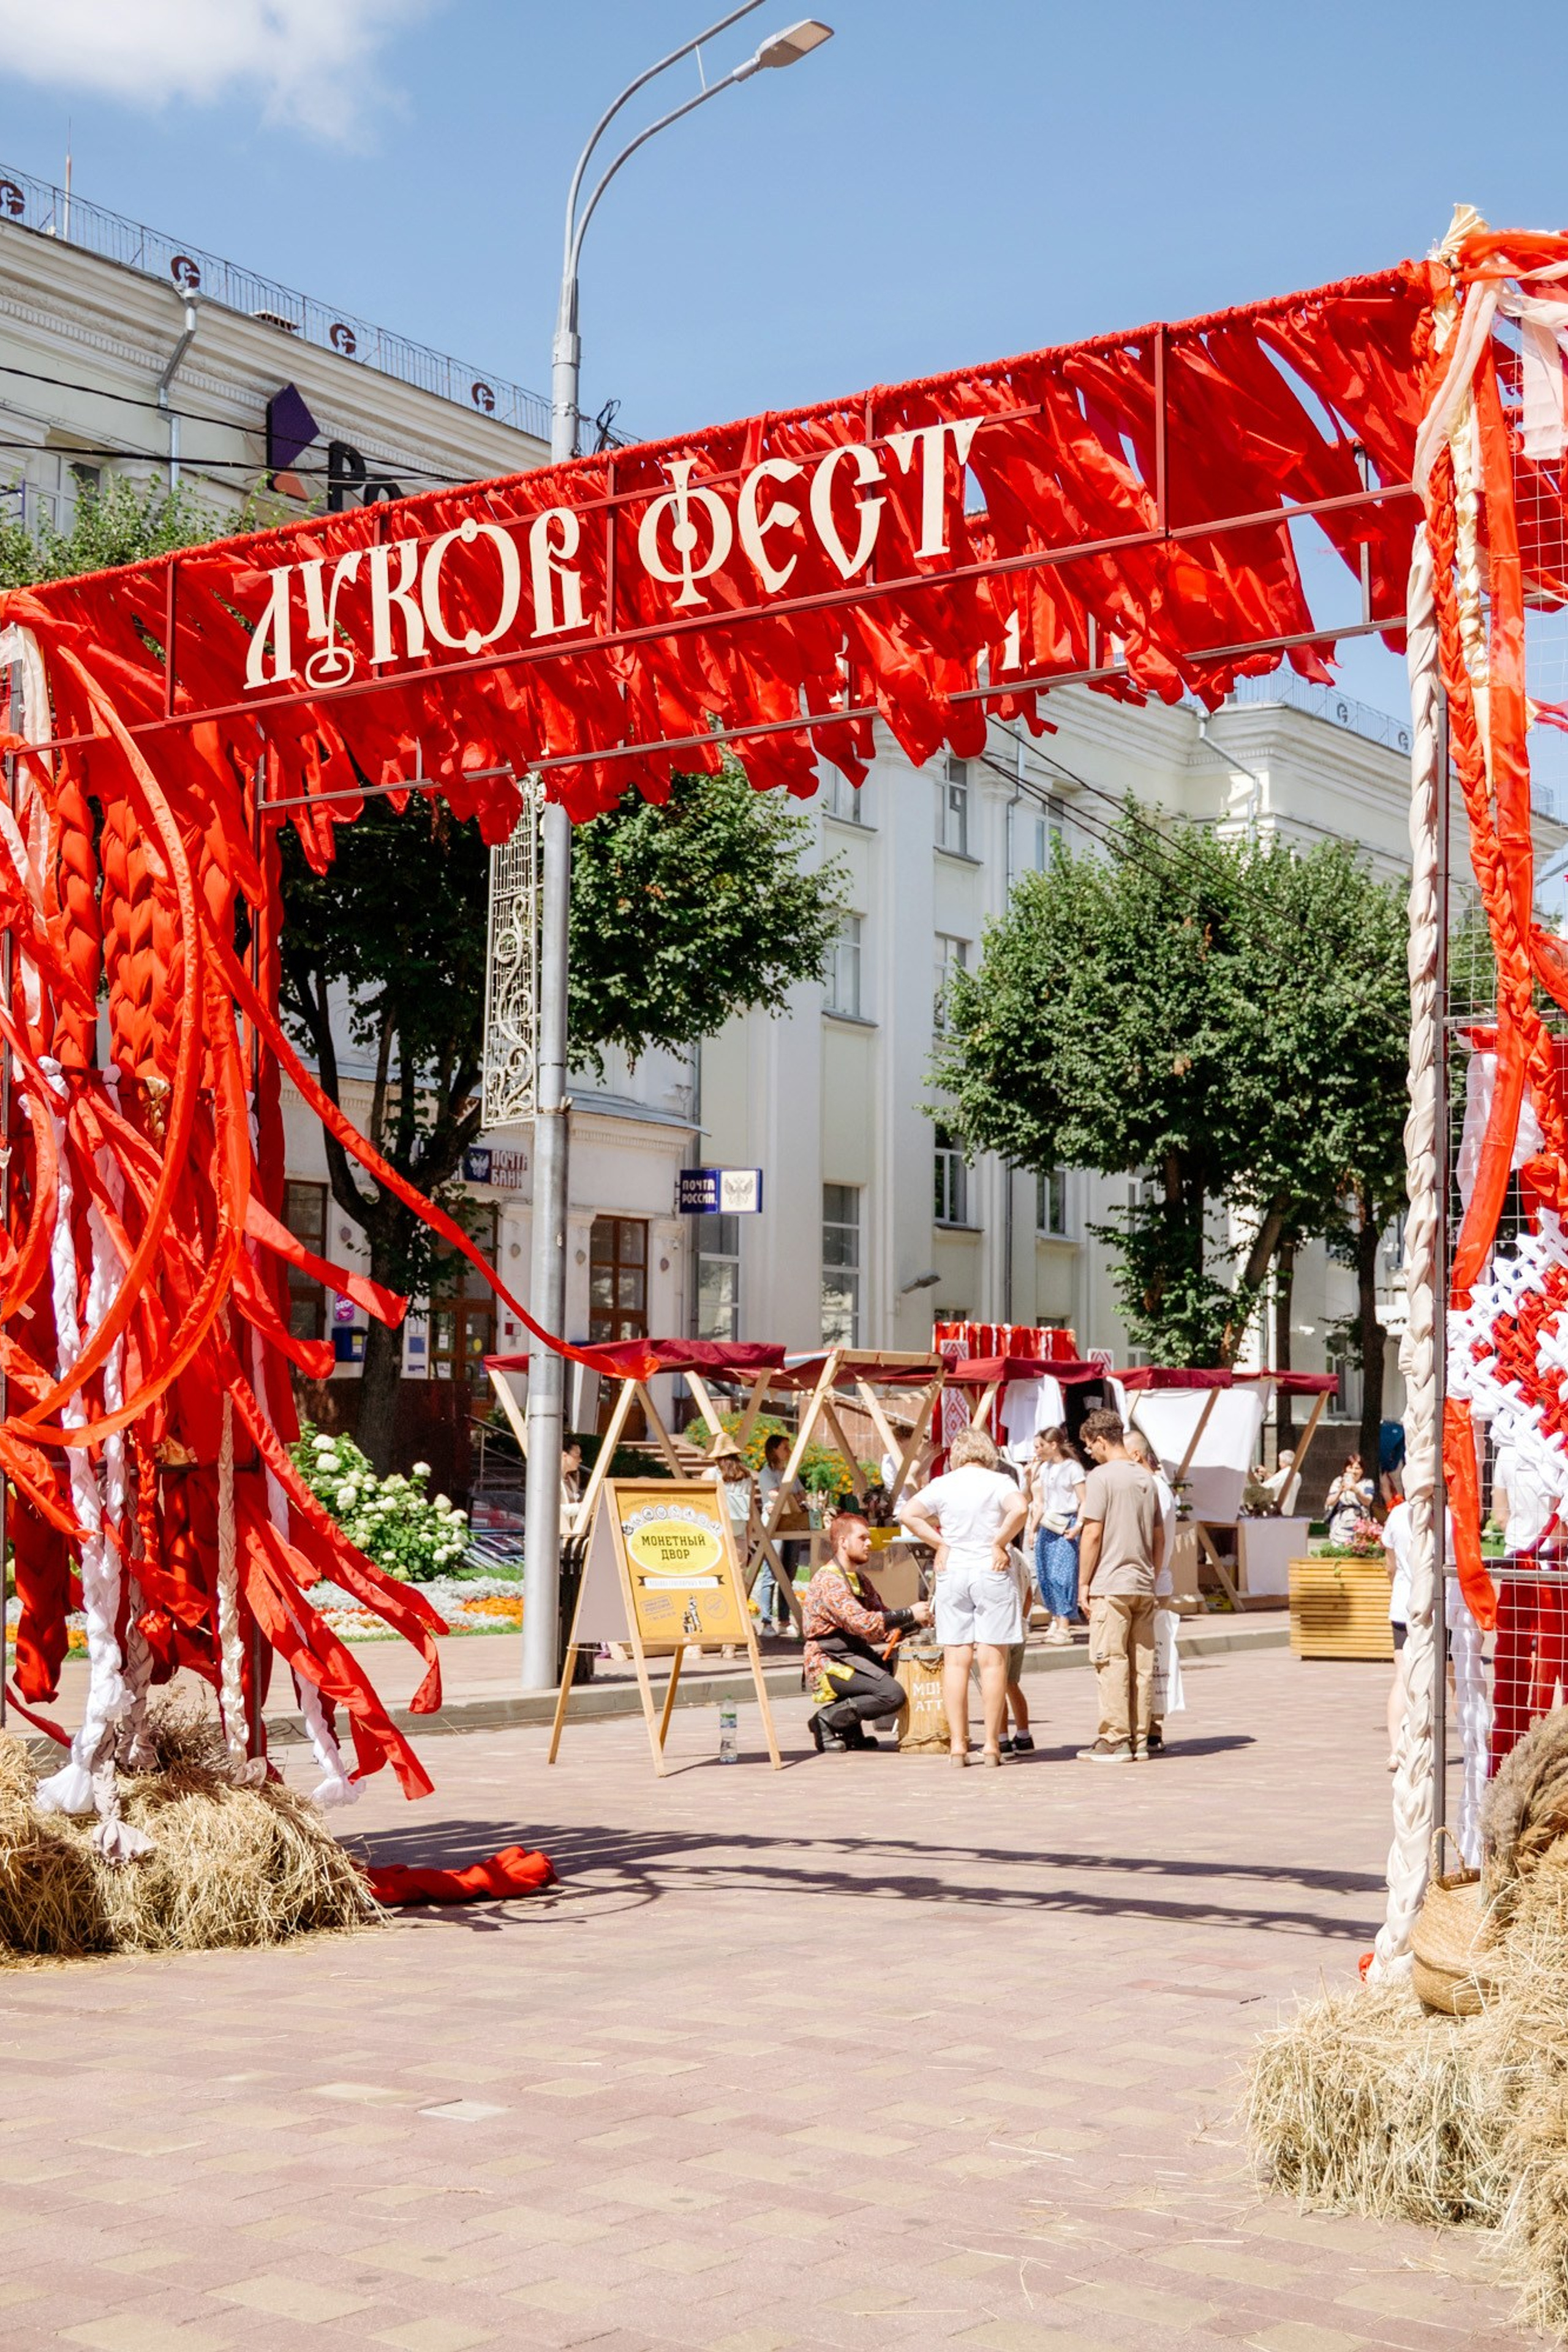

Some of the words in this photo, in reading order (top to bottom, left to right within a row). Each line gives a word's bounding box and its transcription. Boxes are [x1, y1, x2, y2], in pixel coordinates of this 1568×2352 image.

[638, 416, 985, 607] ФЕСТ
[491, 1150, 528, 1170] ПОЧТА
[682, 1179, 715, 1191] ПОЧТА
[682, 1193, 715, 1204] РОССИИ
[641, 1534, 706, 1546] МОНЕТНЫЙ
[662, 1549, 690, 1560] ДВОР
